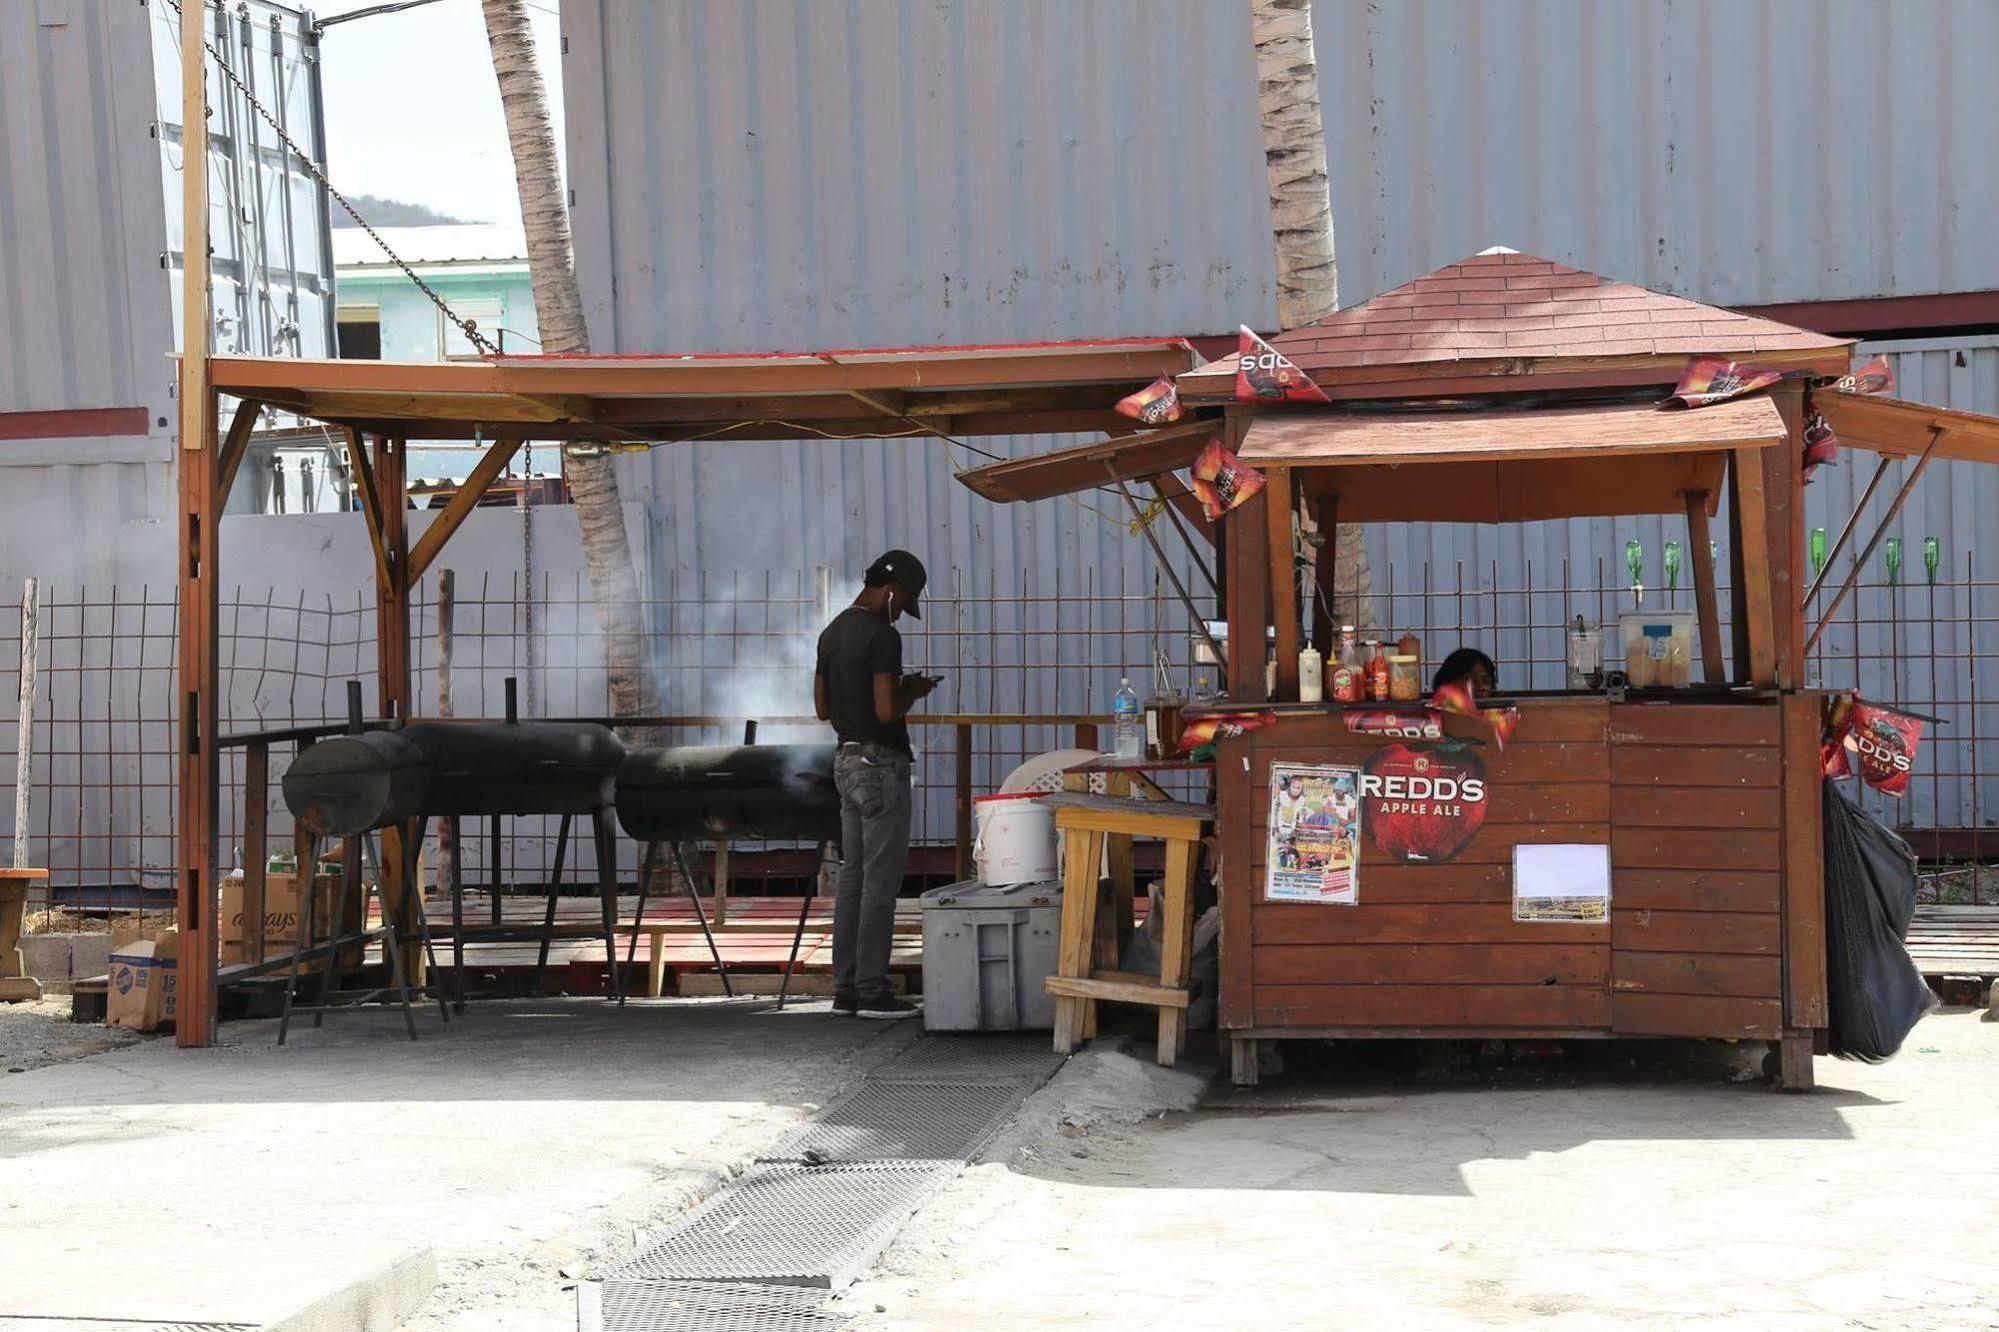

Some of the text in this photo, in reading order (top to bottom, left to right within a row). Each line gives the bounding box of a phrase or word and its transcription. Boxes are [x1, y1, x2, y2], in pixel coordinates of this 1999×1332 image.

[1360, 772, 1485, 802] REDD'S
[1380, 802, 1461, 817] APPLE ALE
